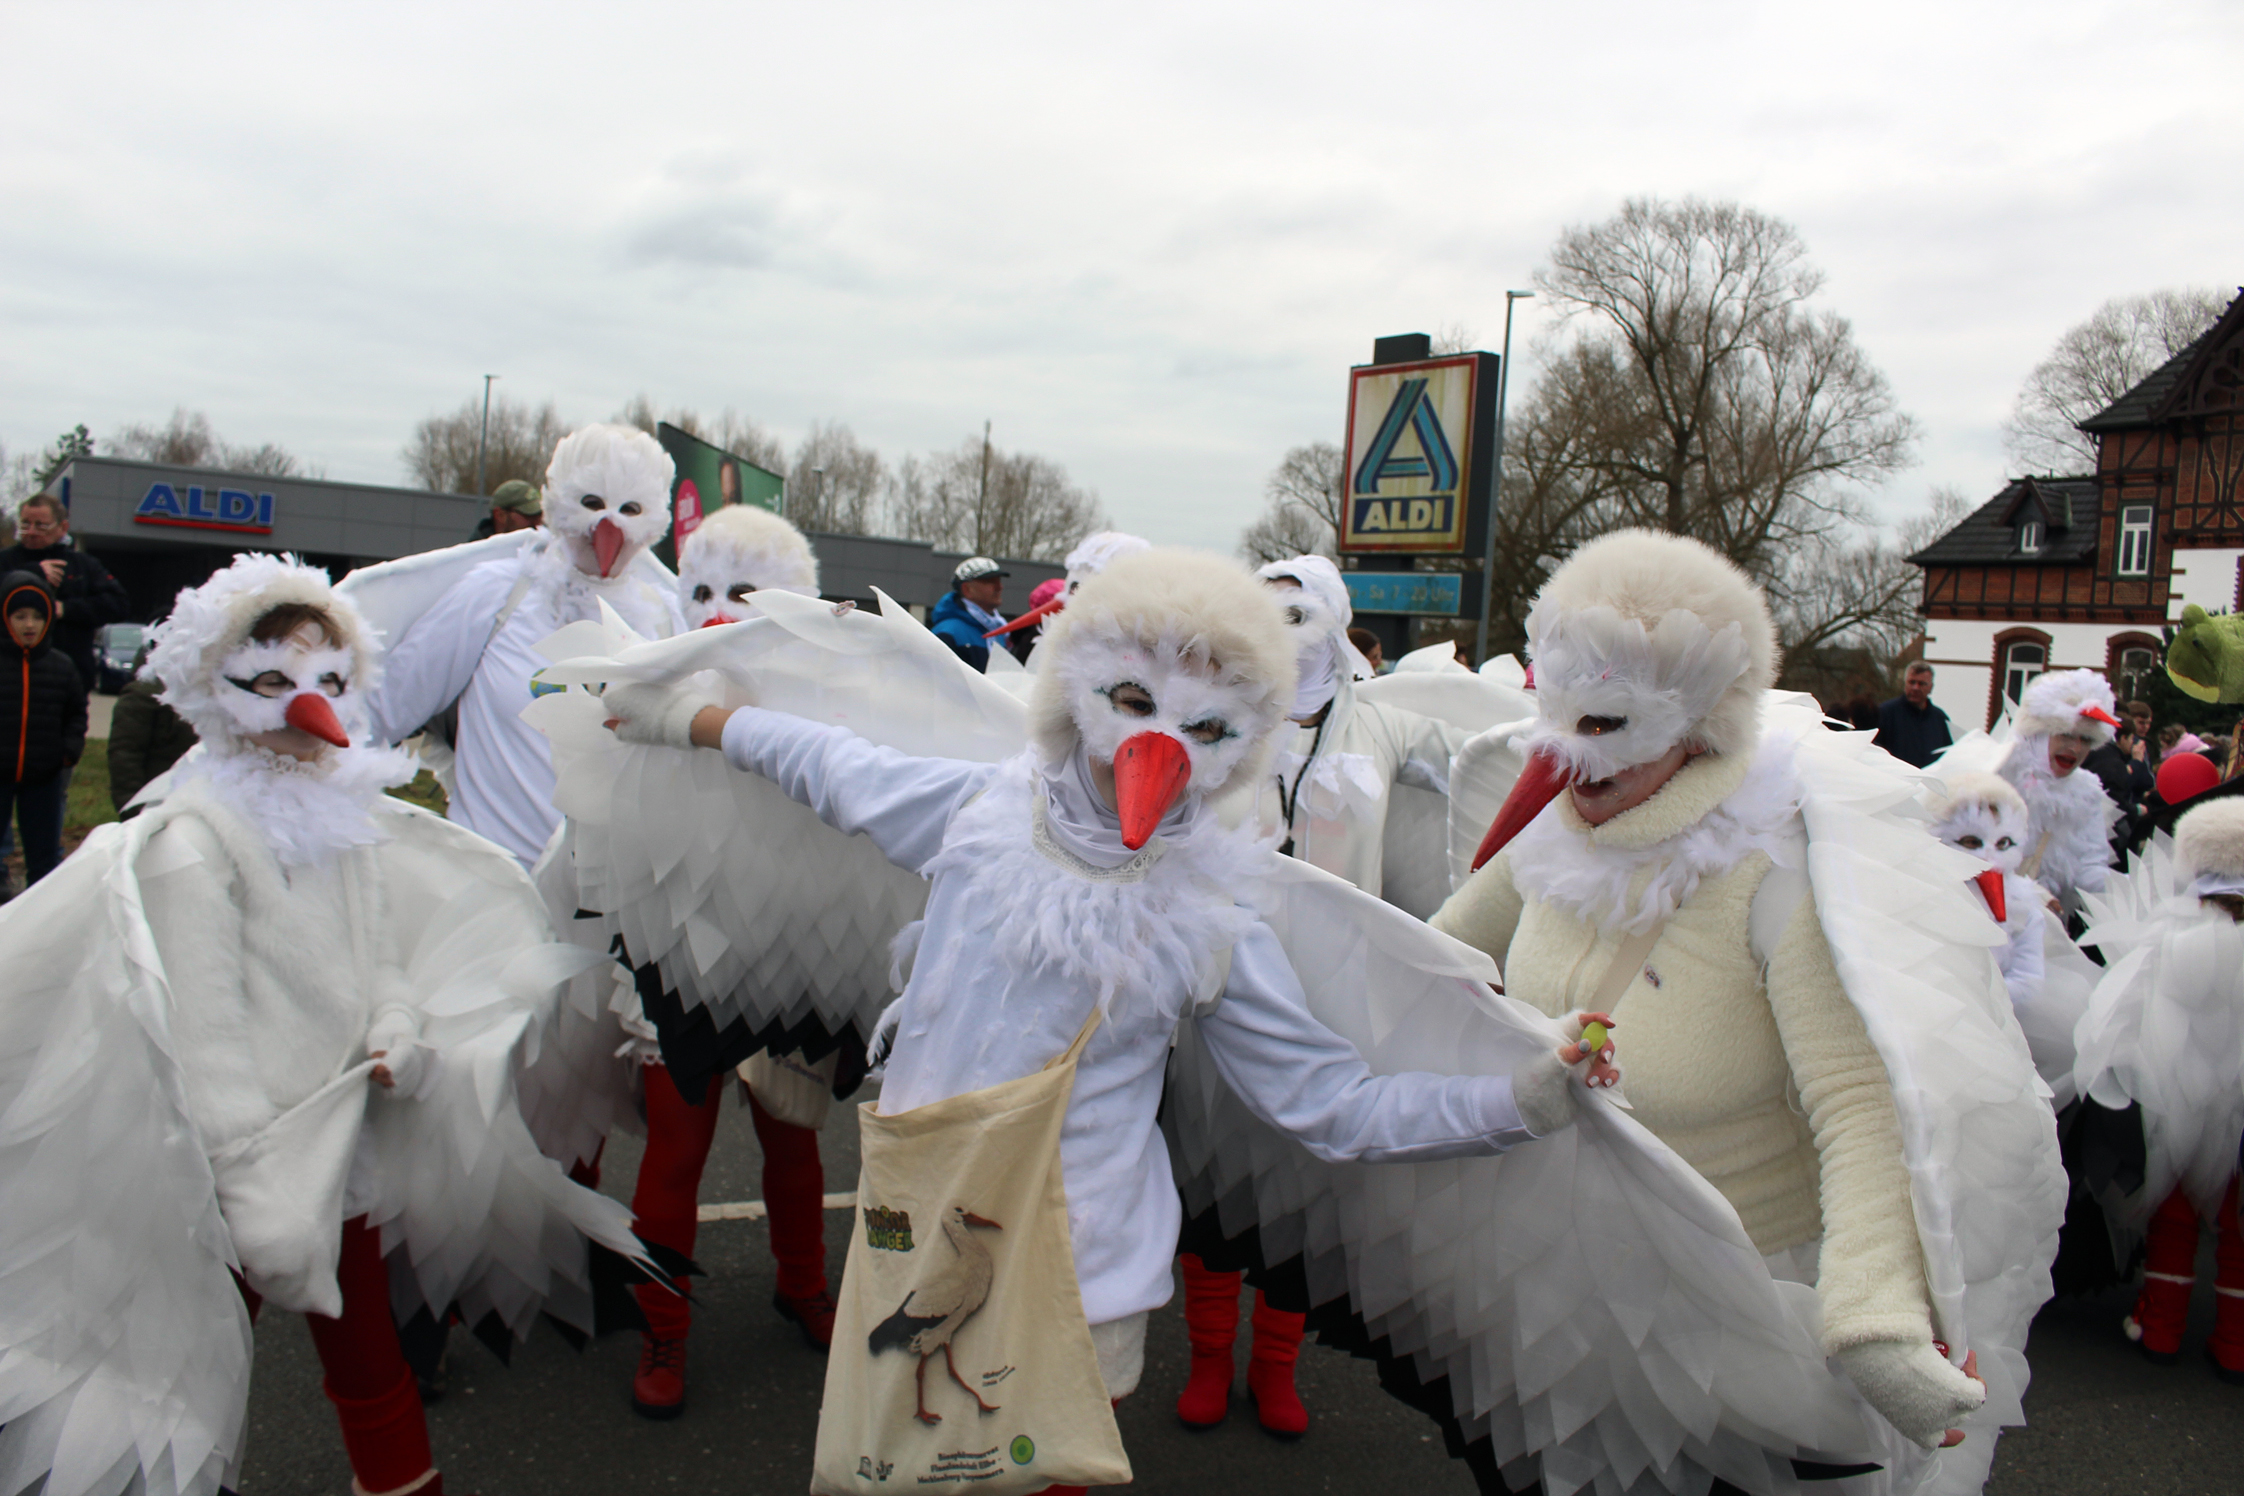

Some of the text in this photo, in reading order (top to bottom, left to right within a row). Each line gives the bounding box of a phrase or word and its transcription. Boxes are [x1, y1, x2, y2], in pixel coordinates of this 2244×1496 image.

[134, 481, 276, 526] ALDI
[1361, 499, 1445, 531] ALDI
[1369, 584, 1385, 599] Sa
[1391, 585, 1400, 600] 7
[1430, 587, 1455, 602] Uhr
